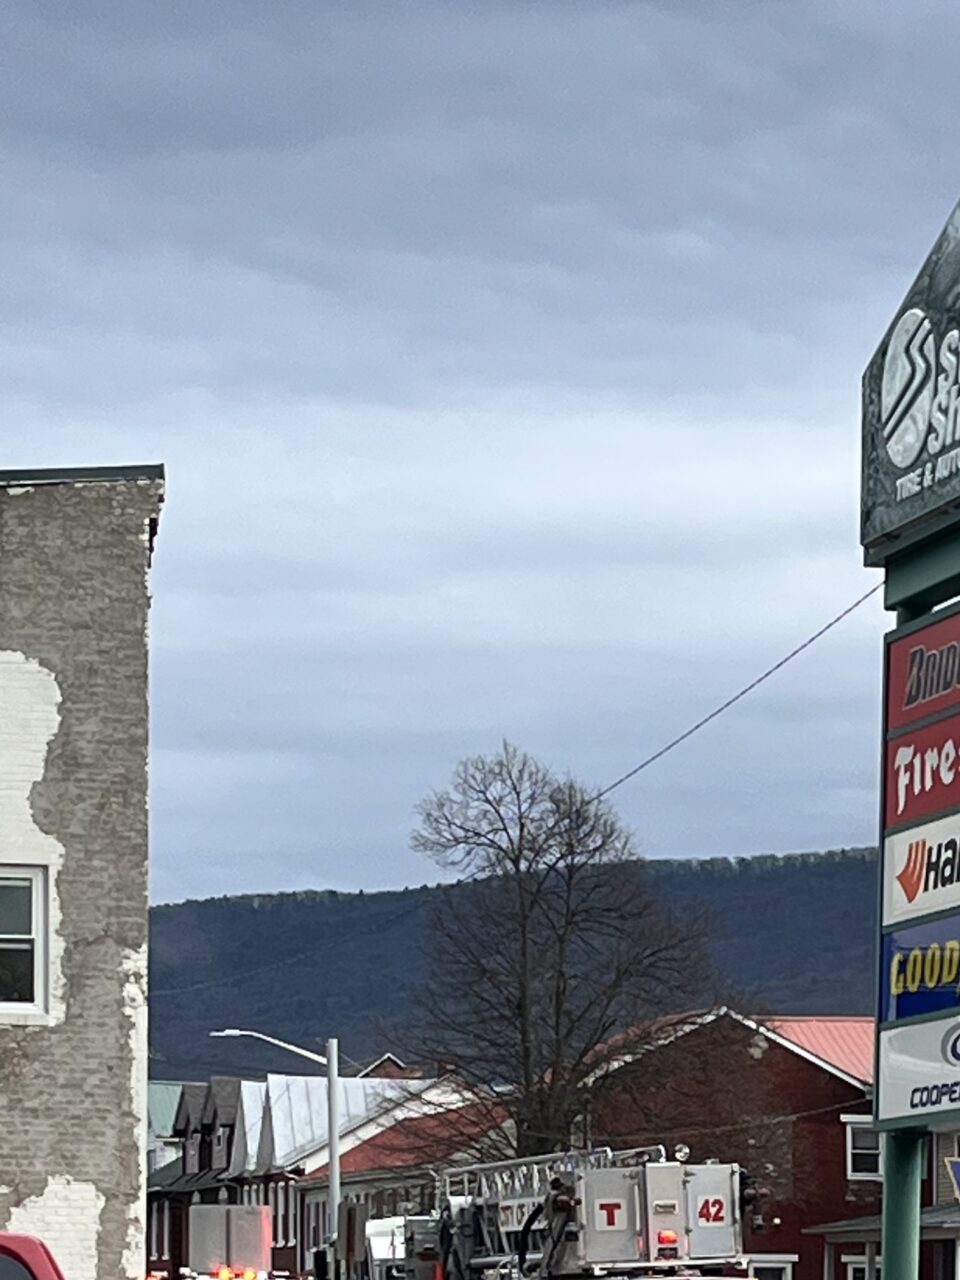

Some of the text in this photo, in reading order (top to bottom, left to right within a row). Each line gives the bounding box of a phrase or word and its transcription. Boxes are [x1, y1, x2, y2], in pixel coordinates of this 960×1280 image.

[923, 462, 934, 488] &
[599, 1199, 724, 1227] T 42
